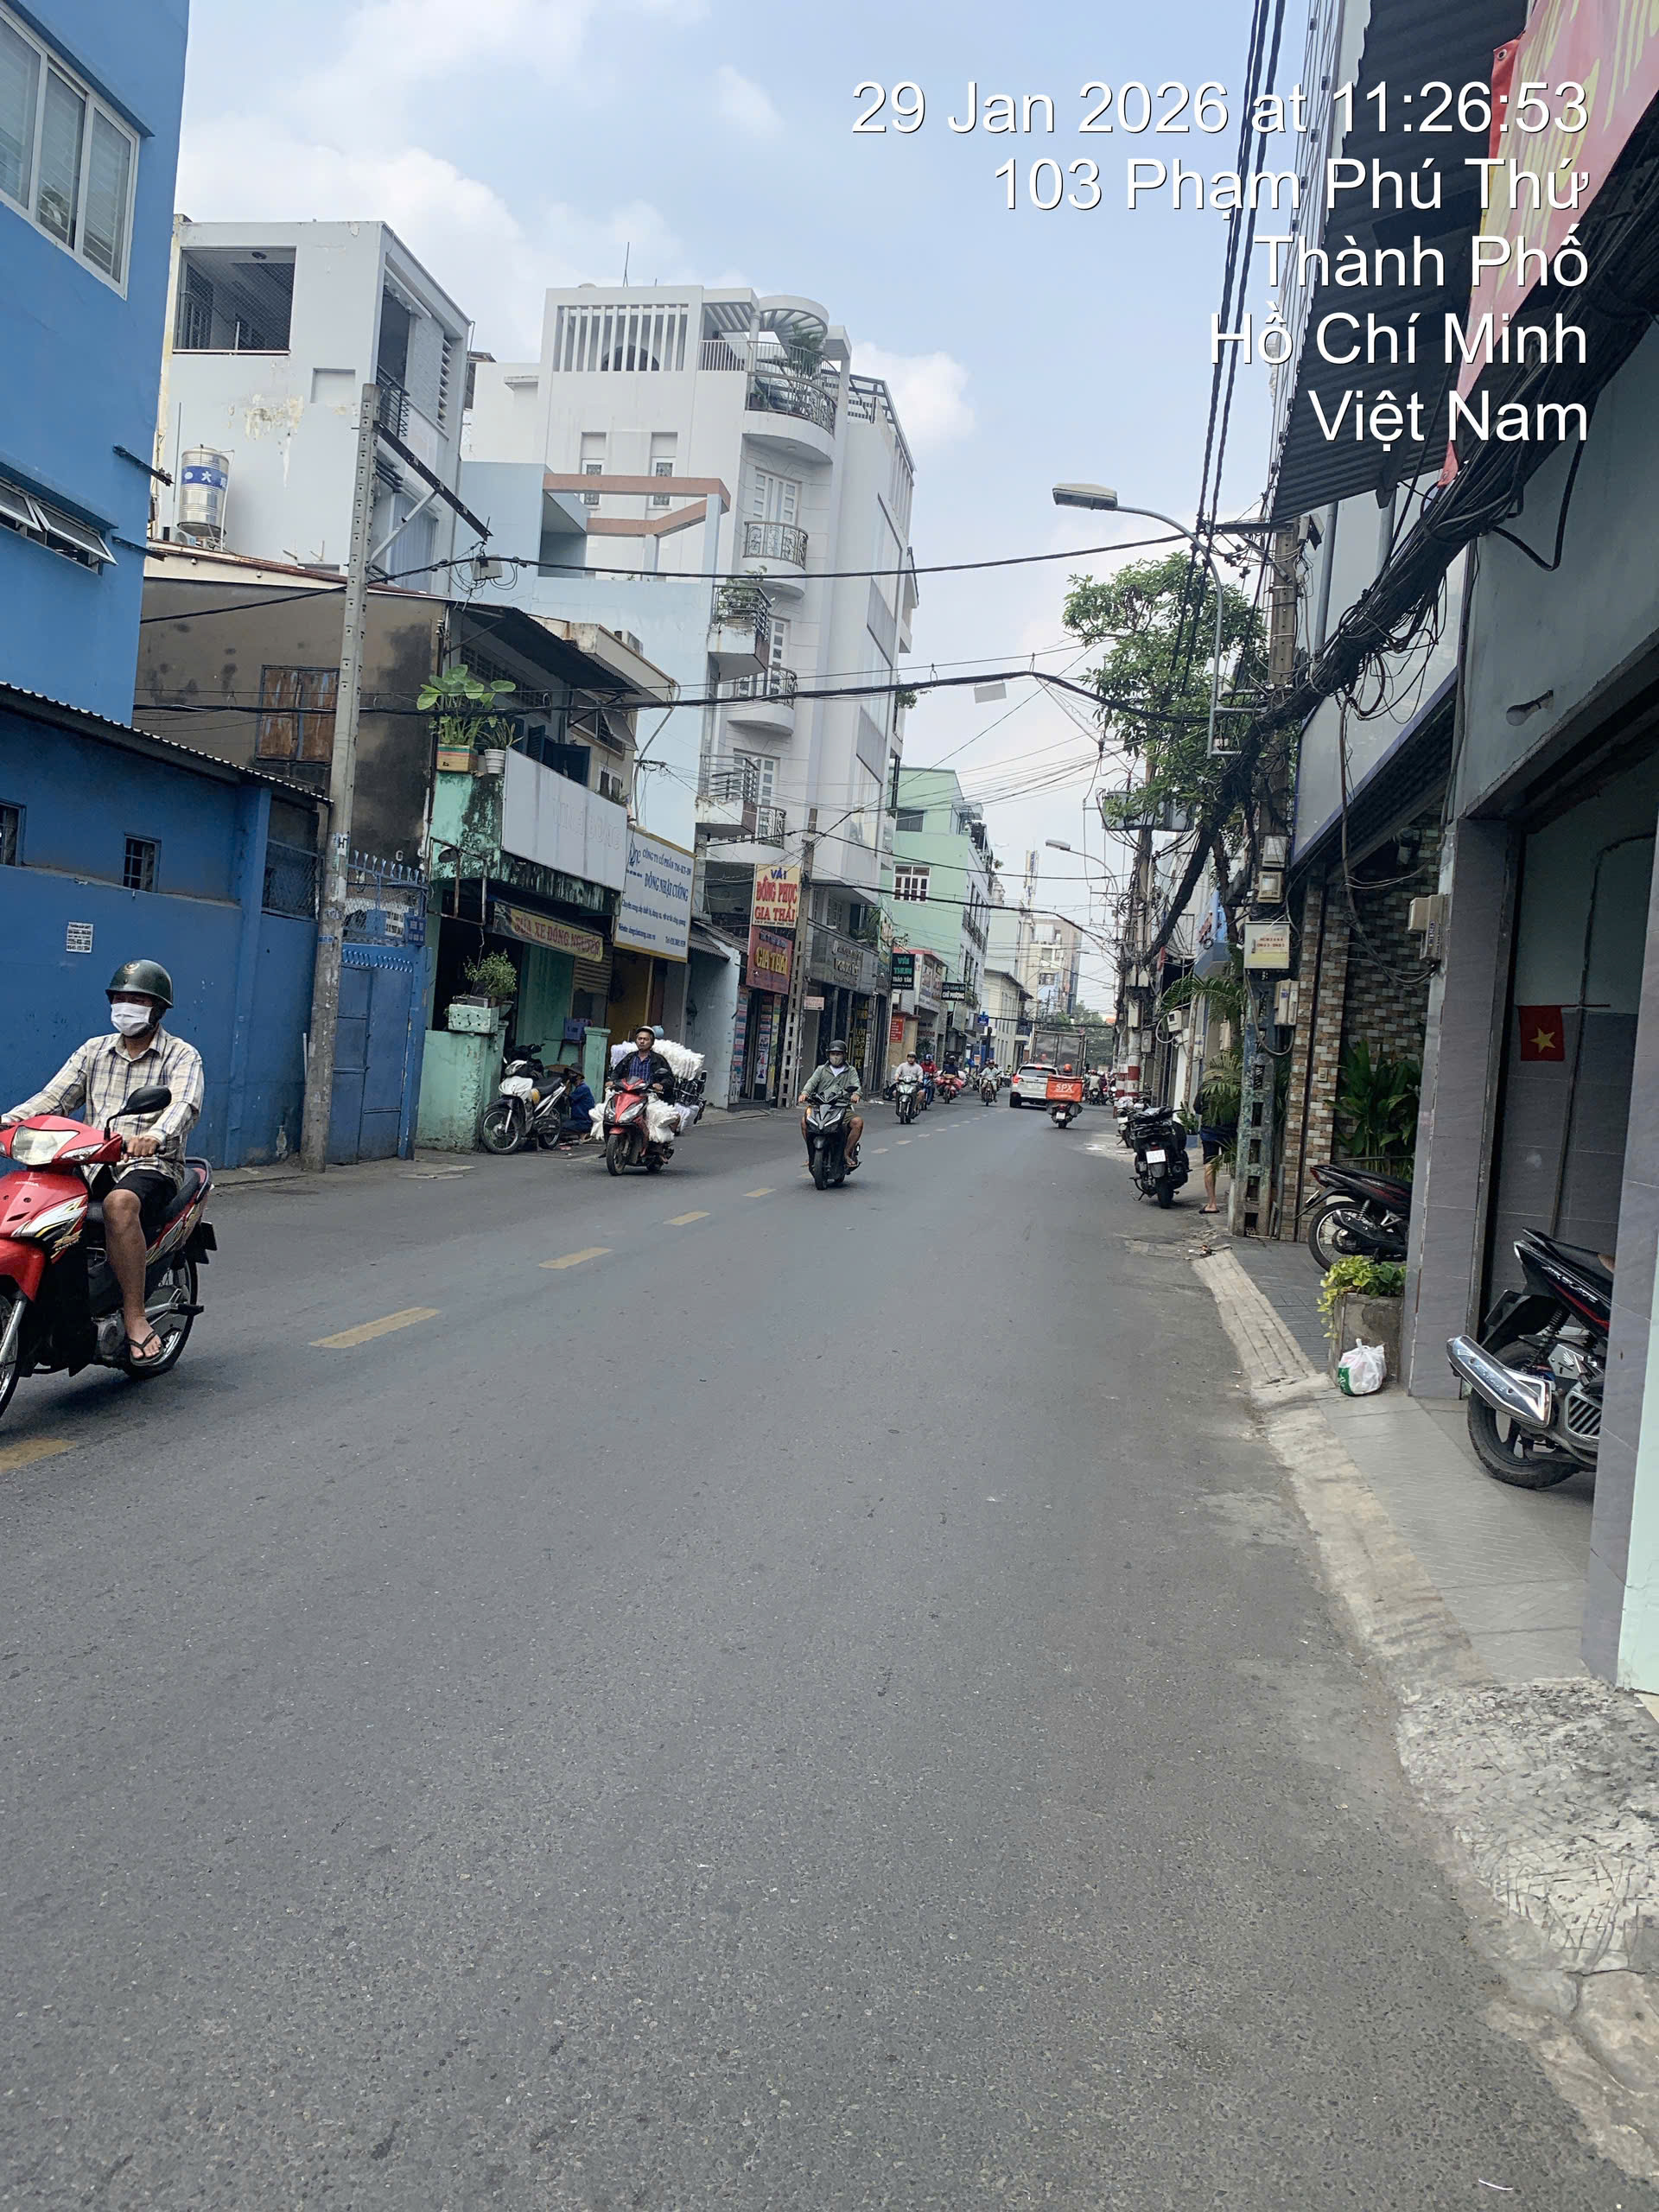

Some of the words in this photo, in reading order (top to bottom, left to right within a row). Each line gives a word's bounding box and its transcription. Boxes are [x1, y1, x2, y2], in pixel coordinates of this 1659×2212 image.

[754, 906, 770, 920] GIA
[756, 946, 769, 969] GIA
[1056, 1084, 1073, 1092] SPX
